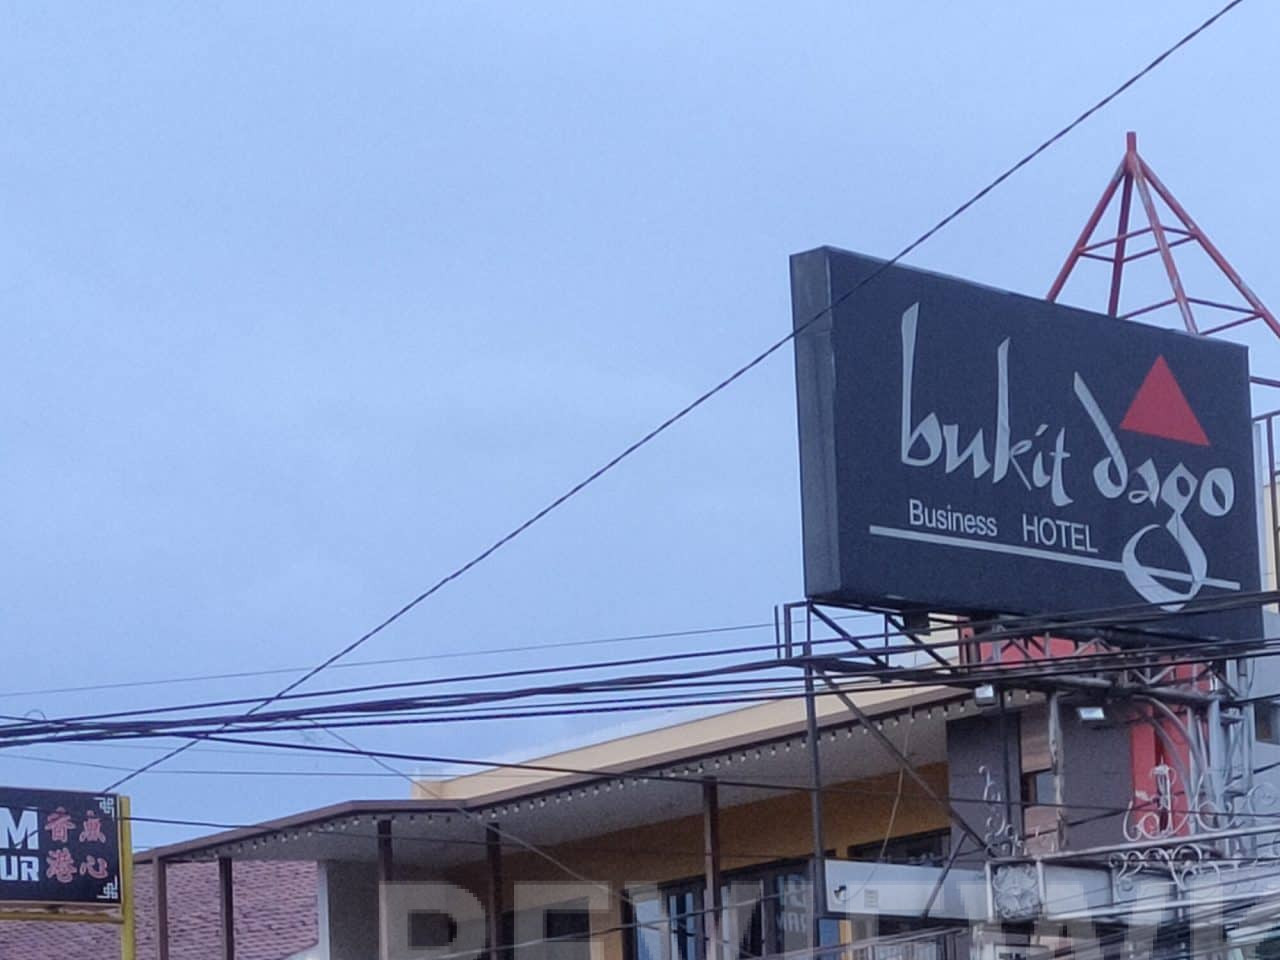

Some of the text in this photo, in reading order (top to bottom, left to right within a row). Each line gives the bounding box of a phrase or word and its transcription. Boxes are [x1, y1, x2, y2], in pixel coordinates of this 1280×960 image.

[901, 302, 1235, 613] bukit dago
[908, 497, 1098, 553] Business HOTEL
